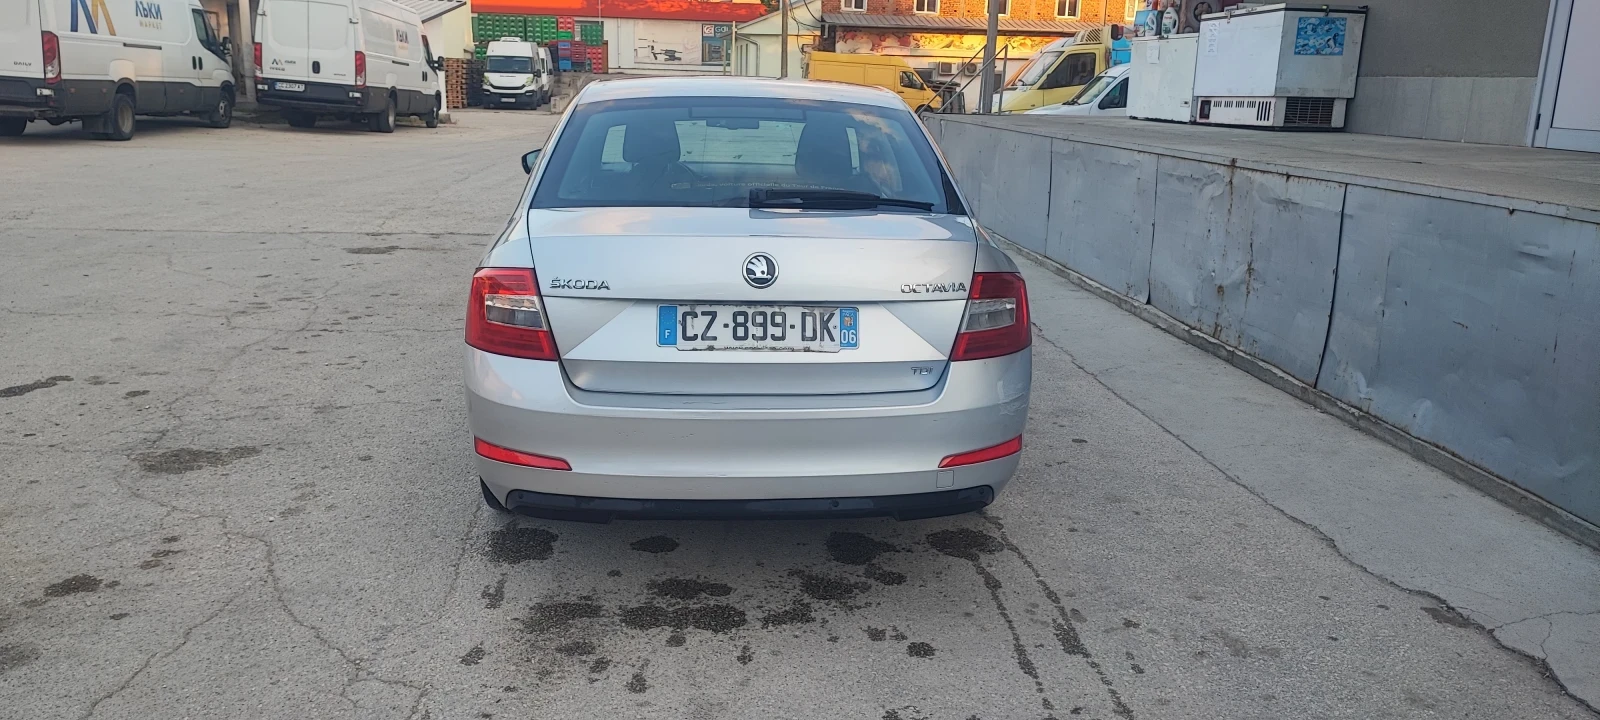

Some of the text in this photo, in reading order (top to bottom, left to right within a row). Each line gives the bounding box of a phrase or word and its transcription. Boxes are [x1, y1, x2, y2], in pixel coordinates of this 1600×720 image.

[900, 282, 967, 293] OCTAVIA
[664, 329, 671, 339] F
[841, 329, 857, 344] 06
[911, 366, 934, 376] TDI
